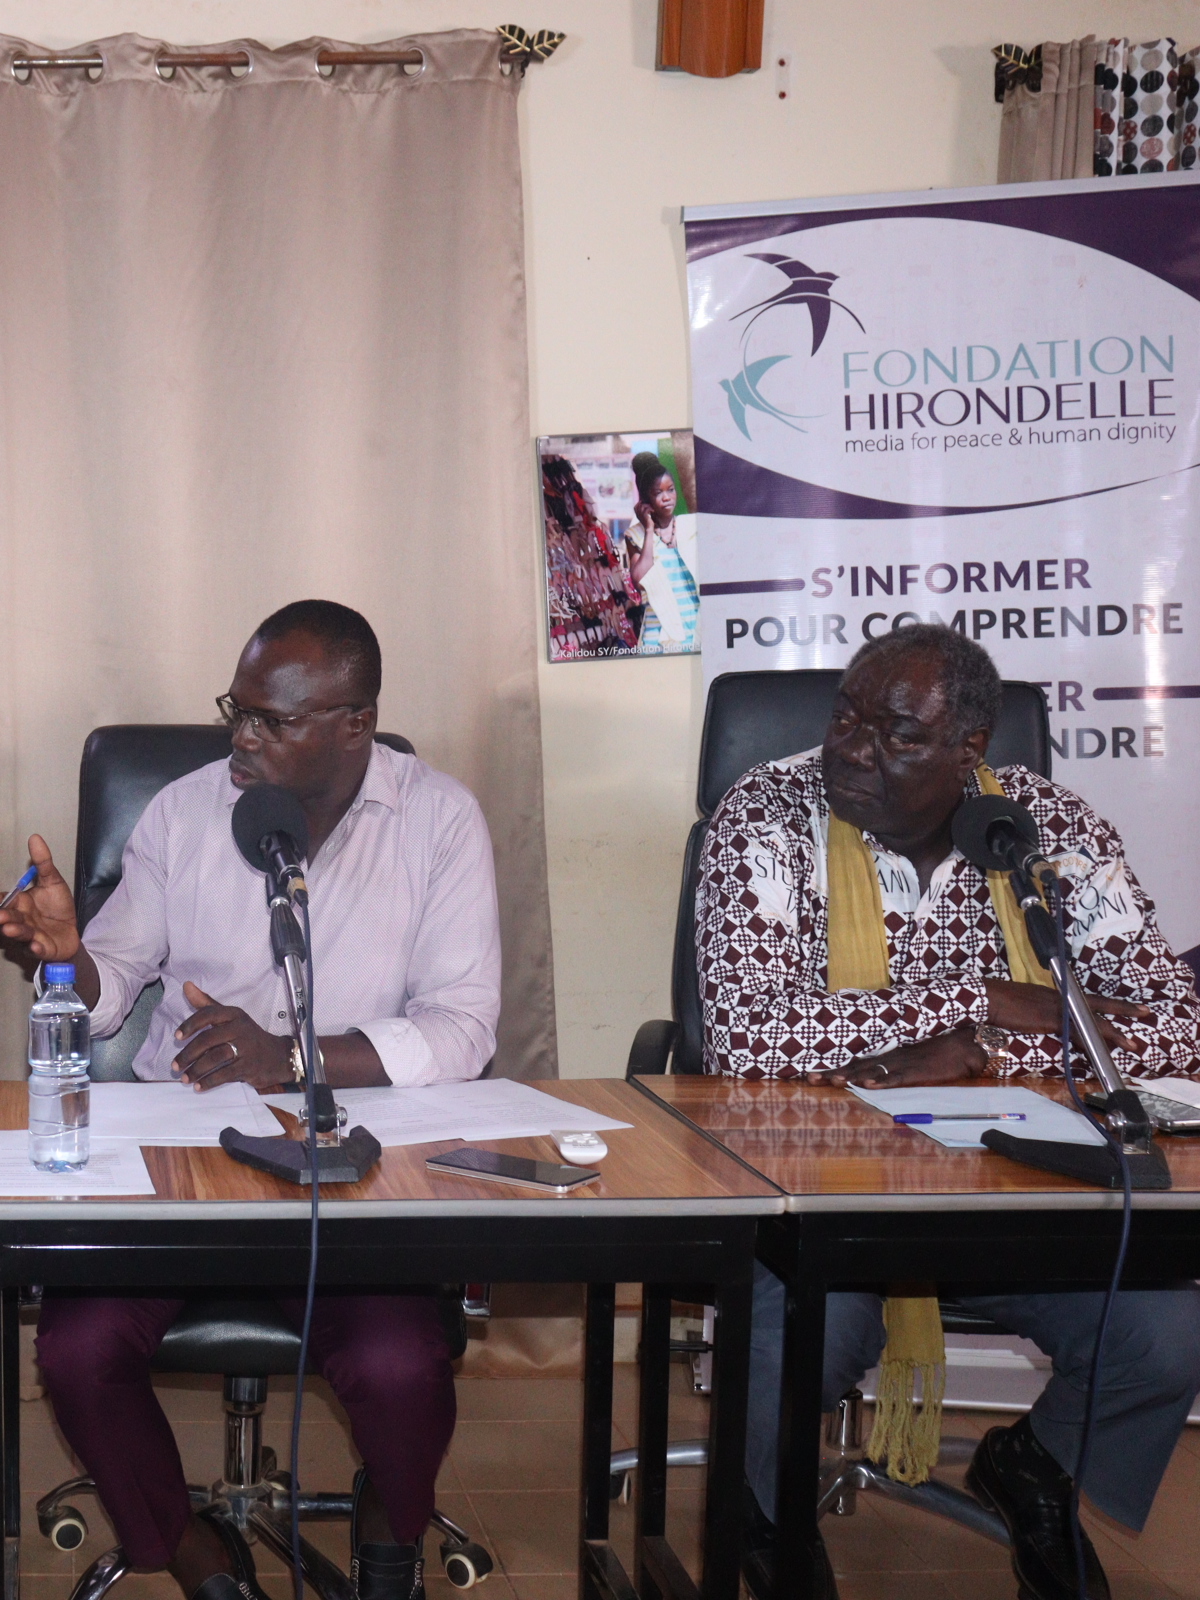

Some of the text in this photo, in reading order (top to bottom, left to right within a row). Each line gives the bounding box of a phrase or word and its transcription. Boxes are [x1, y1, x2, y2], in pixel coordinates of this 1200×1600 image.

[843, 335, 1174, 389] FONDATION
[844, 379, 1176, 431] HIRONDELLE
[845, 421, 1177, 452] media for peace & human dignity
[726, 613, 849, 649] POUR
[560, 648, 596, 658] Kalidou
